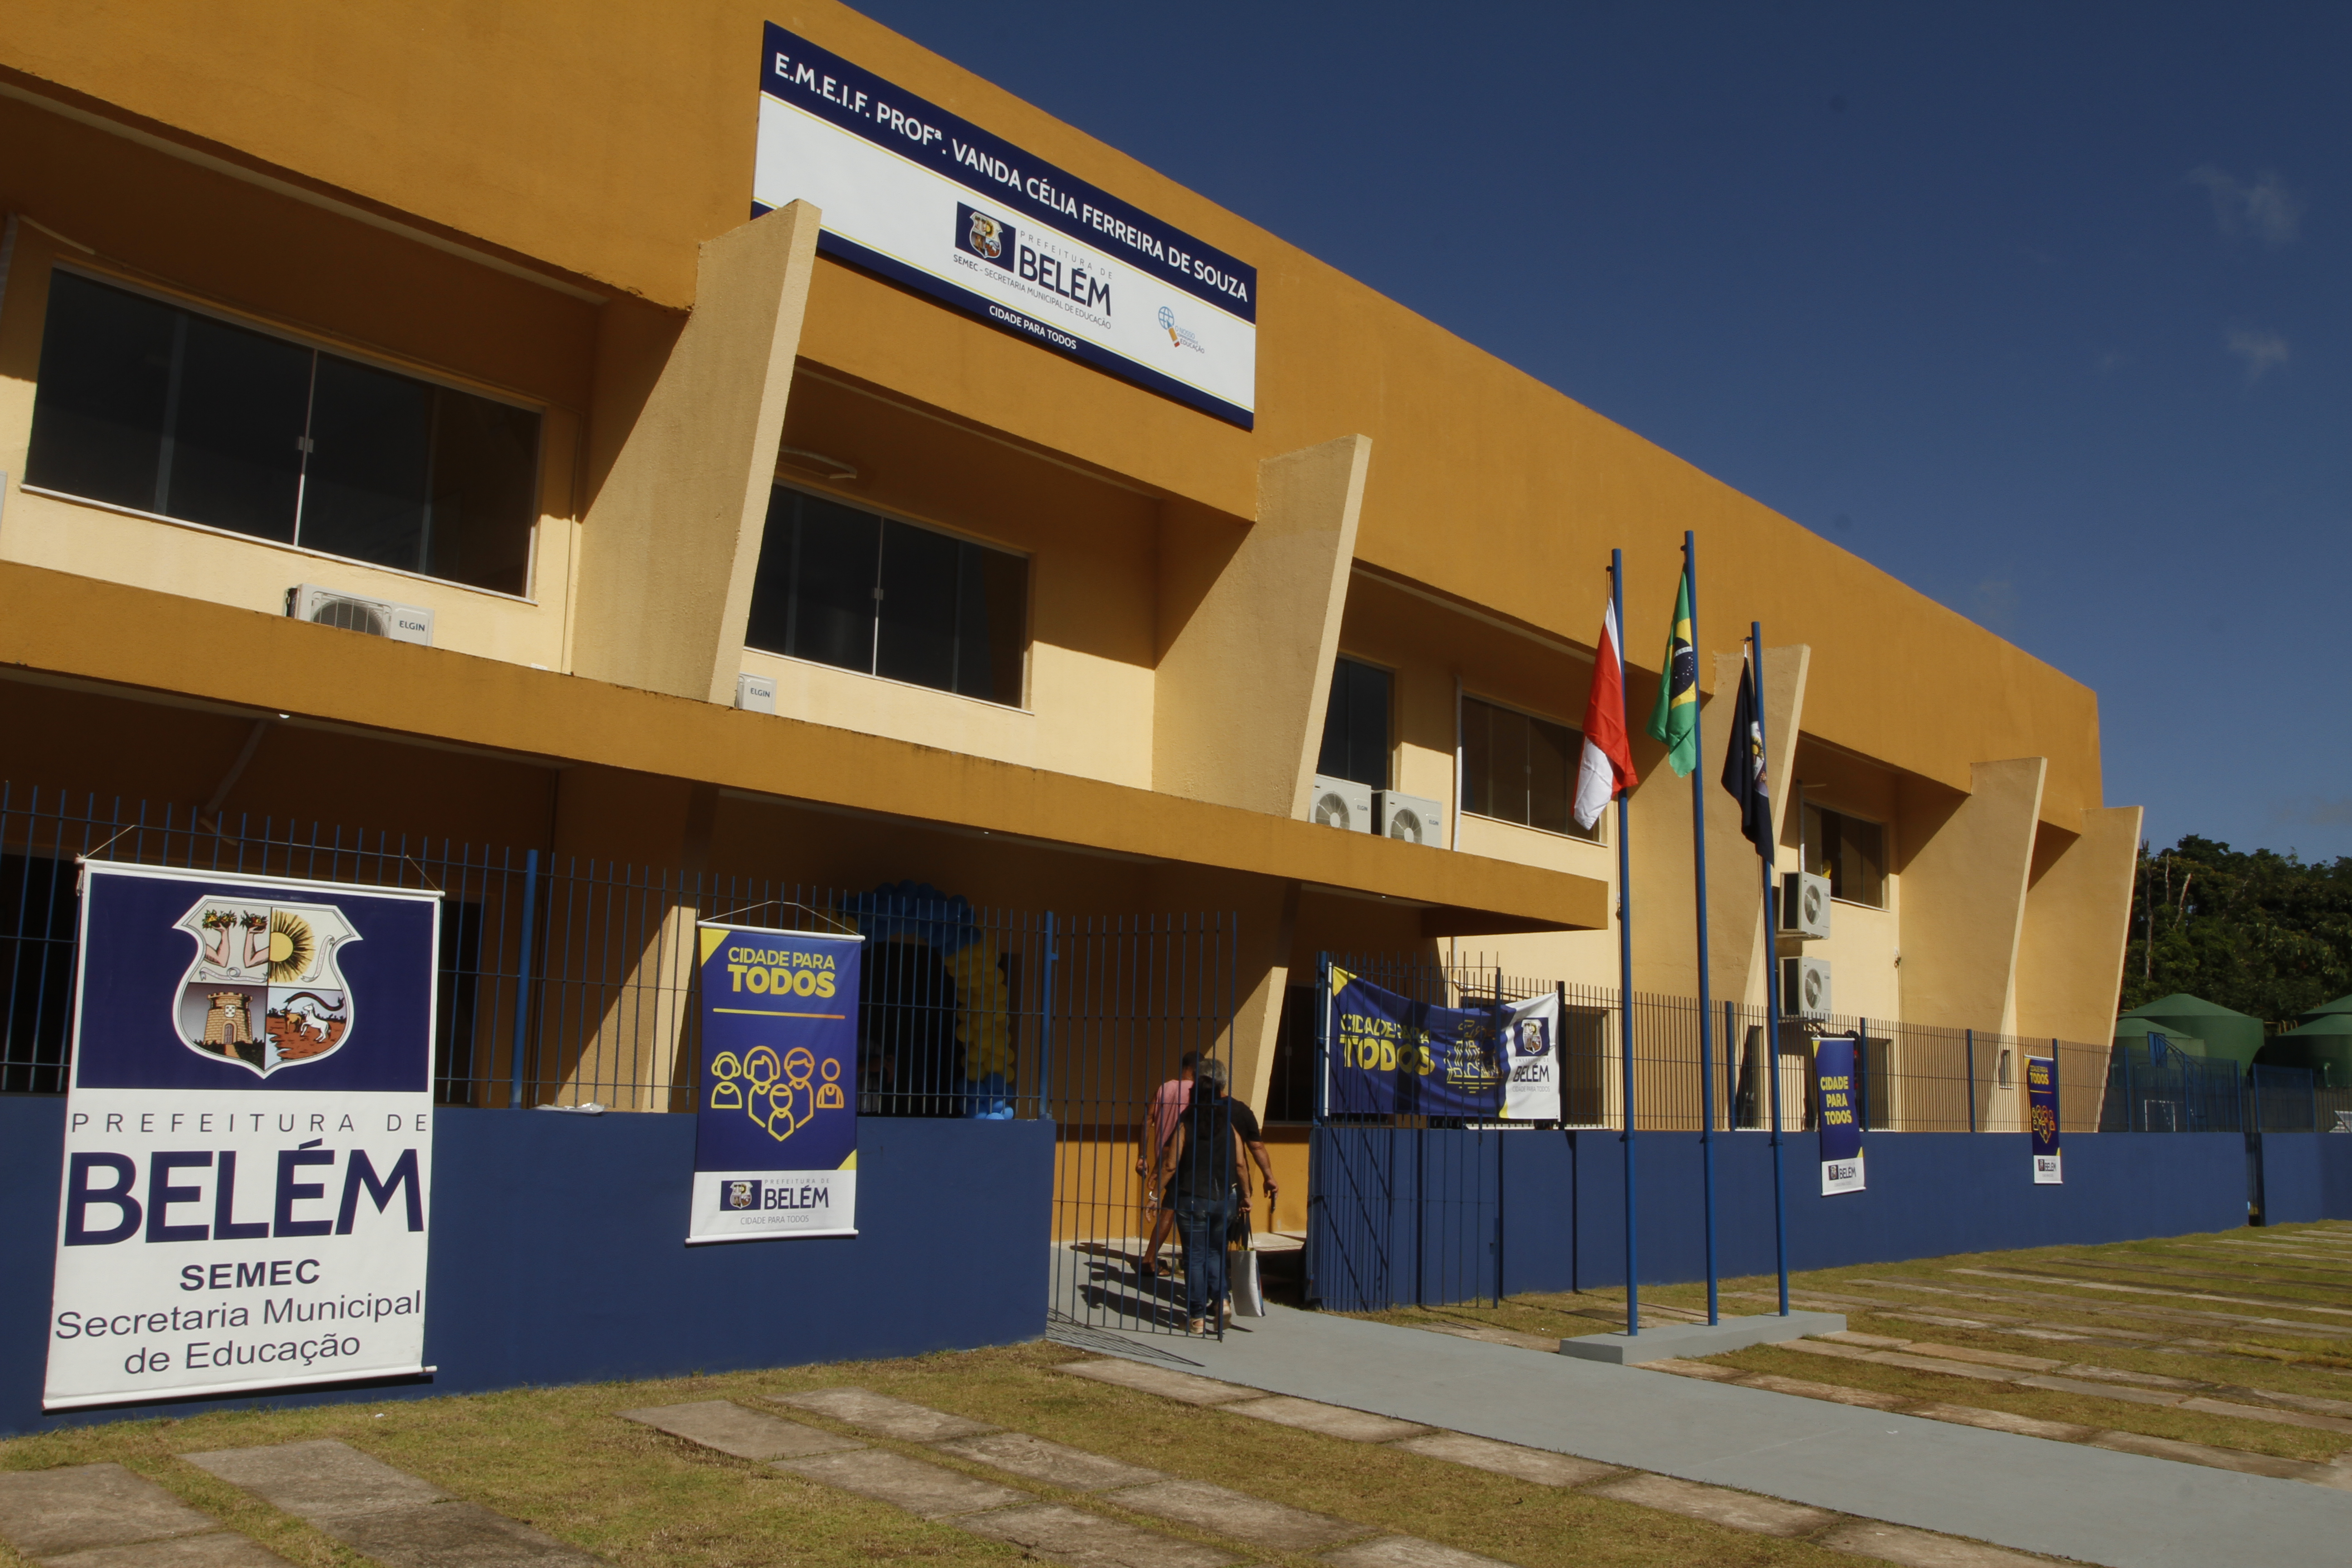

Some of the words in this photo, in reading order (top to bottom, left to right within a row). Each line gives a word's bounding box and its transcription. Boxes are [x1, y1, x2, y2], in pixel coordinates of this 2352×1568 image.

[775, 52, 870, 118] E.M.E.I.F.
[952, 138, 1022, 192] VANDA
[1026, 177, 1078, 219] CÉLIA
[1083, 204, 1164, 261] FERREIRA
[1168, 246, 1191, 274] DE
[1194, 260, 1248, 302] SOUZA
[1020, 230, 1093, 270] PREFEITURA
[1100, 268, 1112, 279] DE
[953, 254, 978, 272] SEMEC
[985, 268, 1026, 293] SECRETARIA
[1027, 287, 1063, 309] MUNICIPAL
[1065, 304, 1074, 314] DE
[1075, 308, 1112, 330] EDUCAÇÃO
[1019, 244, 1111, 317] BELÉM
[989, 305, 1022, 327] CIDADE
[1024, 320, 1046, 337] PARA
[1047, 329, 1077, 350] TODOS
[1180, 338, 1205, 354] EDUCAÇÃO
[399, 620, 426, 632] ELGIN
[750, 687, 770, 698] ELGIN
[728, 946, 790, 967] CIDADE
[793, 952, 836, 970] PARA
[727, 964, 836, 998] TODOS
[1341, 1014, 1396, 1039] CIDADE
[1339, 1034, 1436, 1076] TODOS
[1513, 1063, 1550, 1082] BELÉM
[1820, 1076, 1849, 1091] CIDADE
[2029, 1072, 2049, 1085] TODOS
[1826, 1093, 1848, 1107] PARA
[70, 1112, 355, 1133] PREFEITURA
[386, 1113, 427, 1132] DE
[1824, 1109, 1852, 1125] TODOS
[1839, 1166, 1857, 1179] BELÉM
[64, 1137, 424, 1246] BELÉM
[764, 1185, 829, 1210] BELÉM
[740, 1216, 766, 1225] CIDADE
[787, 1215, 809, 1223] TODOS
[179, 1259, 320, 1291] SEMEC
[55, 1302, 249, 1339] Secretaria
[263, 1290, 421, 1324] Municipal
[124, 1347, 171, 1374] de
[185, 1333, 361, 1368] Educação
